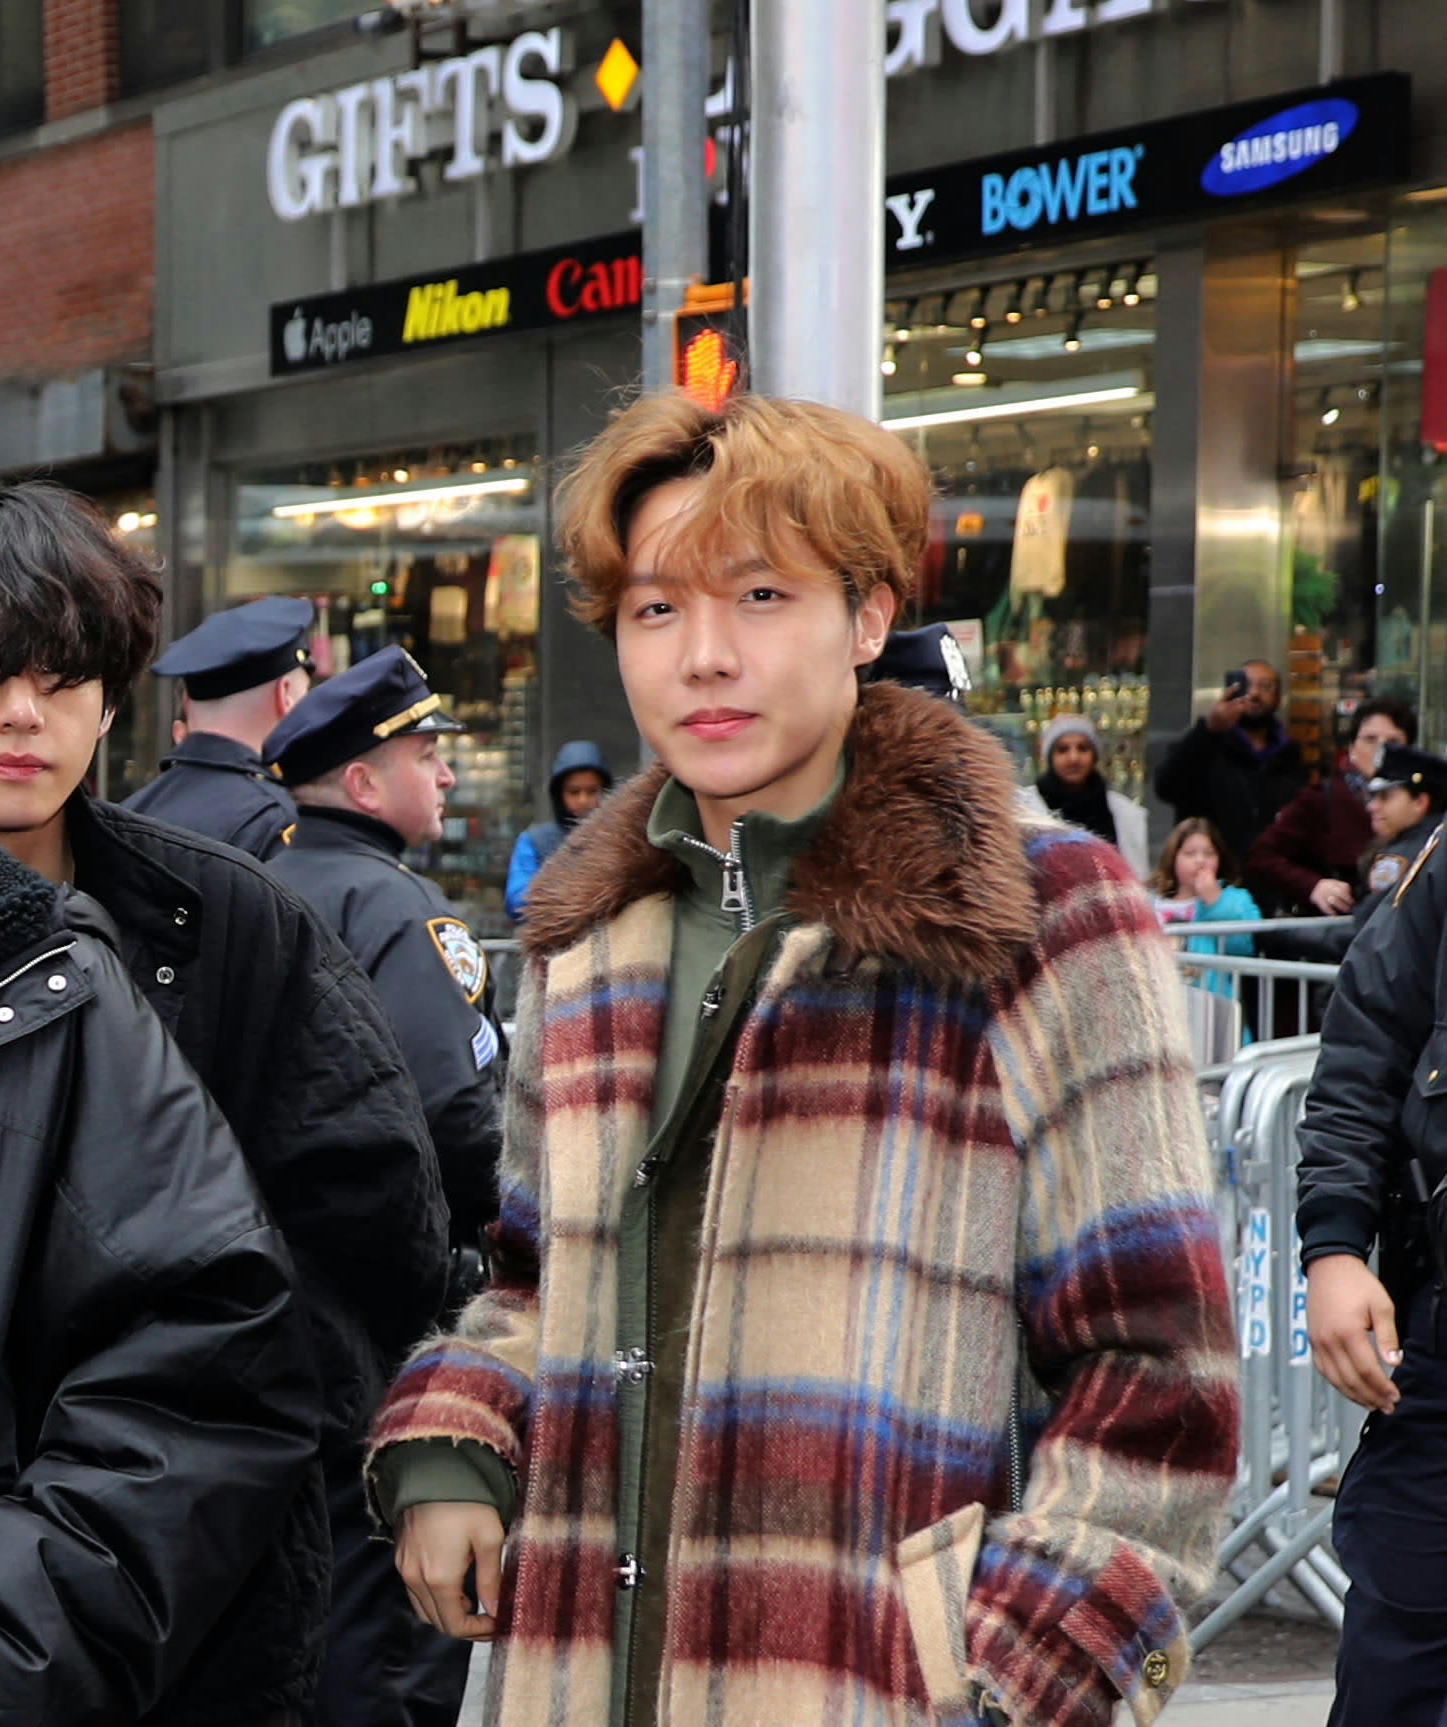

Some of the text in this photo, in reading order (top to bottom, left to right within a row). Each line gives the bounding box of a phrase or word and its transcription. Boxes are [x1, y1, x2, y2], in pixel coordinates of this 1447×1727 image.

[267, 27, 565, 221] GIFTS
[1220, 120, 1340, 174] SAMSUNG
[981, 146, 1138, 236] BOWER
[403, 281, 509, 342] Nikon
[547, 254, 644, 318] Can
[310, 311, 371, 361] Apple
[1249, 1213, 1268, 1348] NYPD
